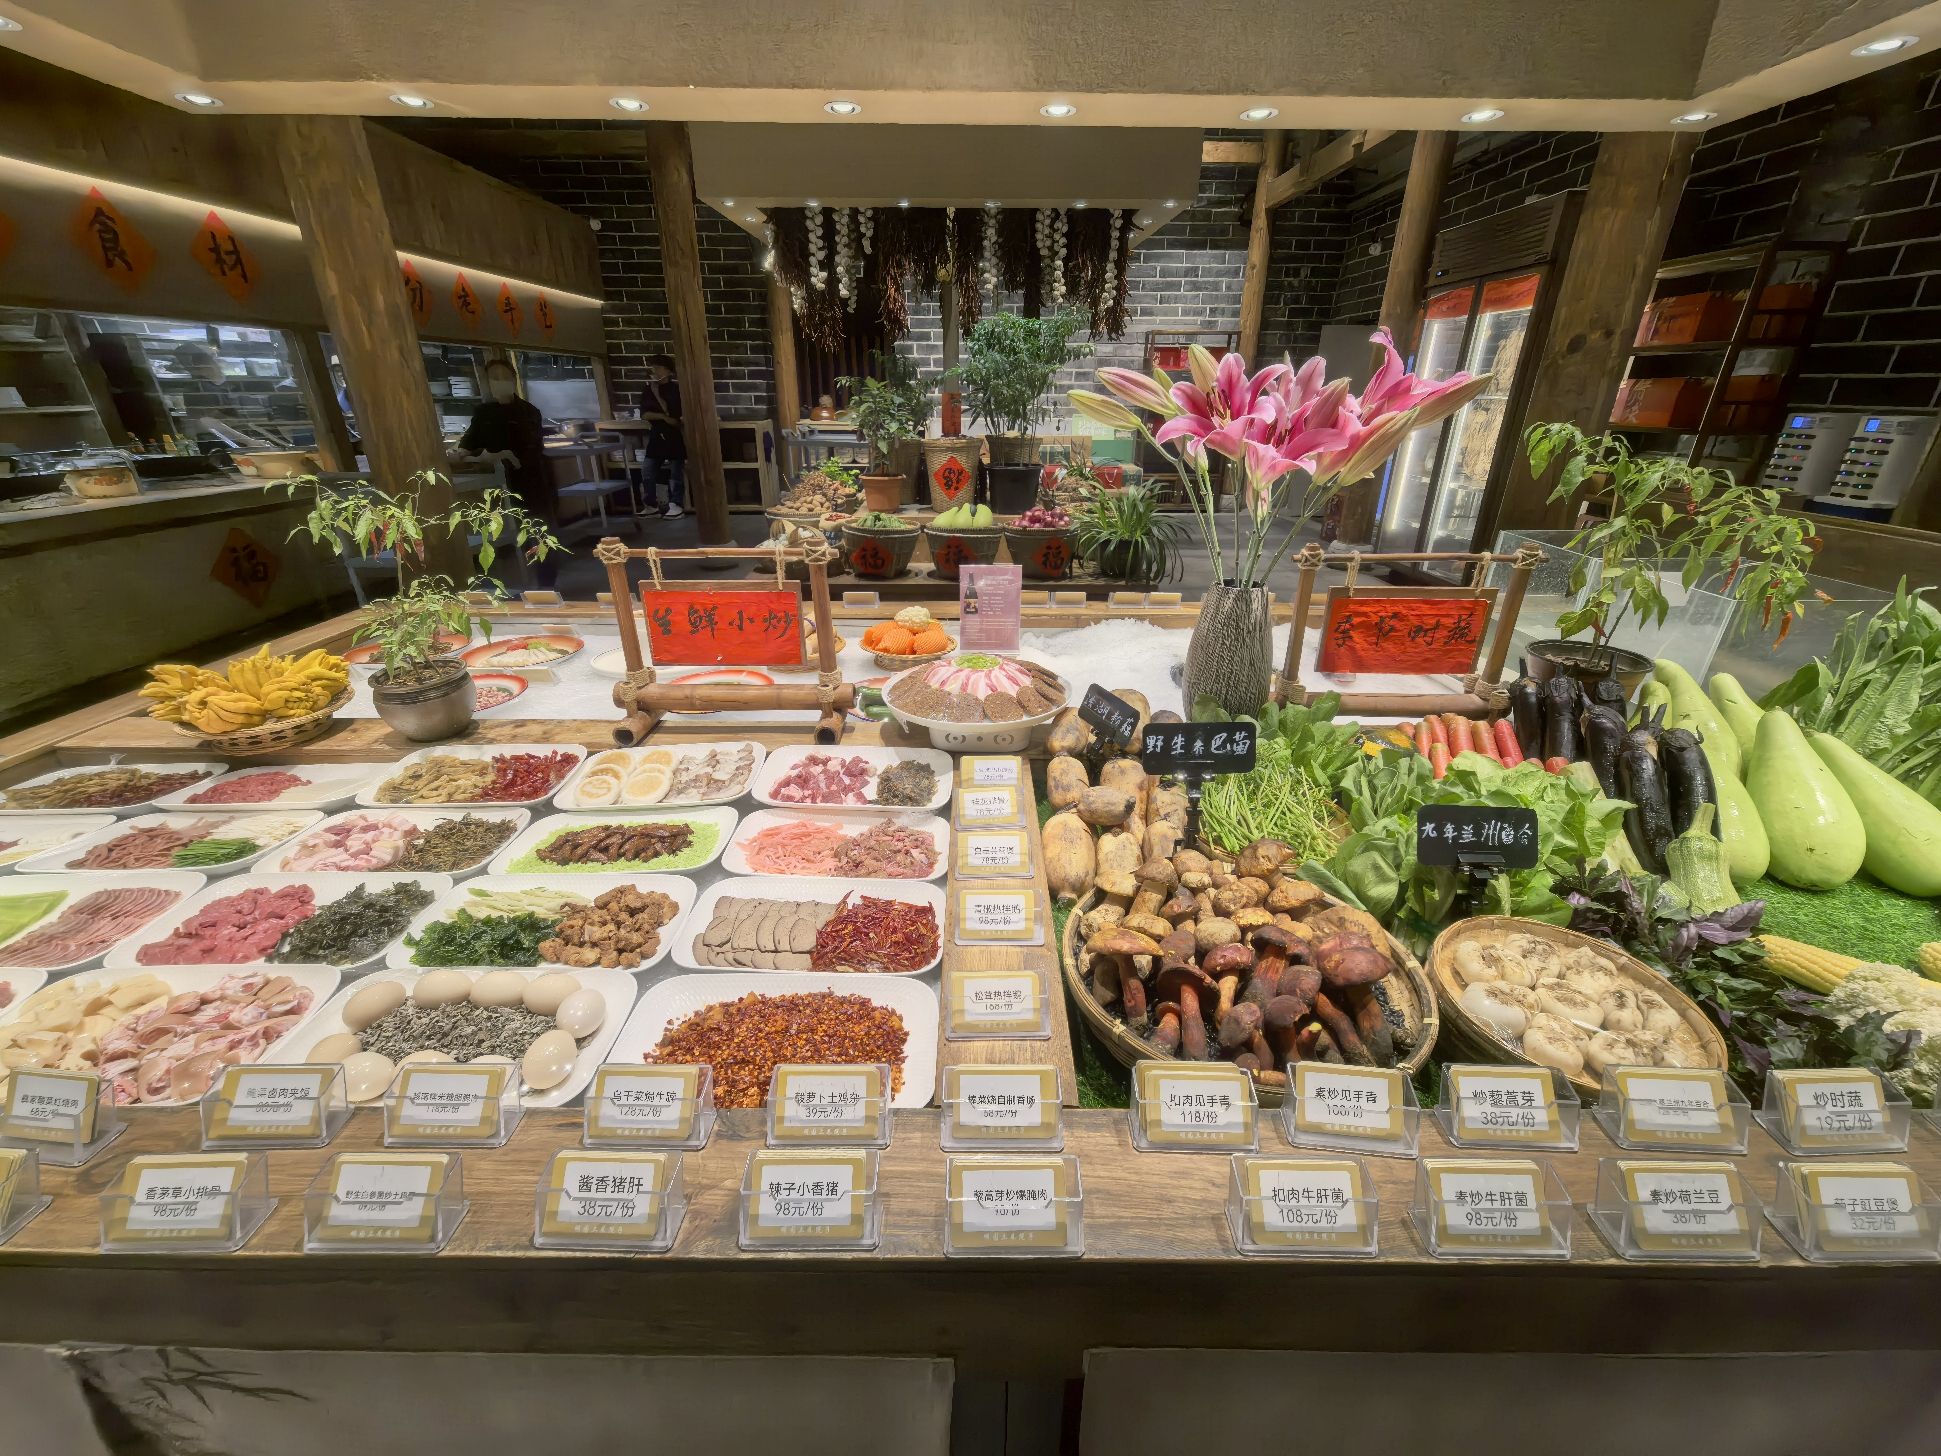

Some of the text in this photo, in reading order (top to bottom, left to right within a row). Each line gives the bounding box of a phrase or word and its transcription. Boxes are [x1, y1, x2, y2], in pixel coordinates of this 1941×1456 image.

[858, 545, 887, 570] 福
[1041, 544, 1065, 570] 福
[652, 602, 796, 641] 生鲜小炒
[1812, 1090, 1864, 1108] 炒时蔬
[805, 1106, 844, 1119] 39元/份
[1480, 1110, 1536, 1128] 38元/份
[1815, 1114, 1873, 1131] 19元/份
[577, 1174, 644, 1194] 酱香猪肝
[768, 1181, 839, 1197] 辣子小香猪
[1454, 1190, 1529, 1207] 素炒牛肝菌
[152, 1204, 197, 1218] 98元/份
[577, 1200, 636, 1218] 38元/份
[774, 1202, 824, 1217] 98元/份
[1278, 1208, 1338, 1225] 108元/份
[1465, 1211, 1518, 1227] 98元/份
